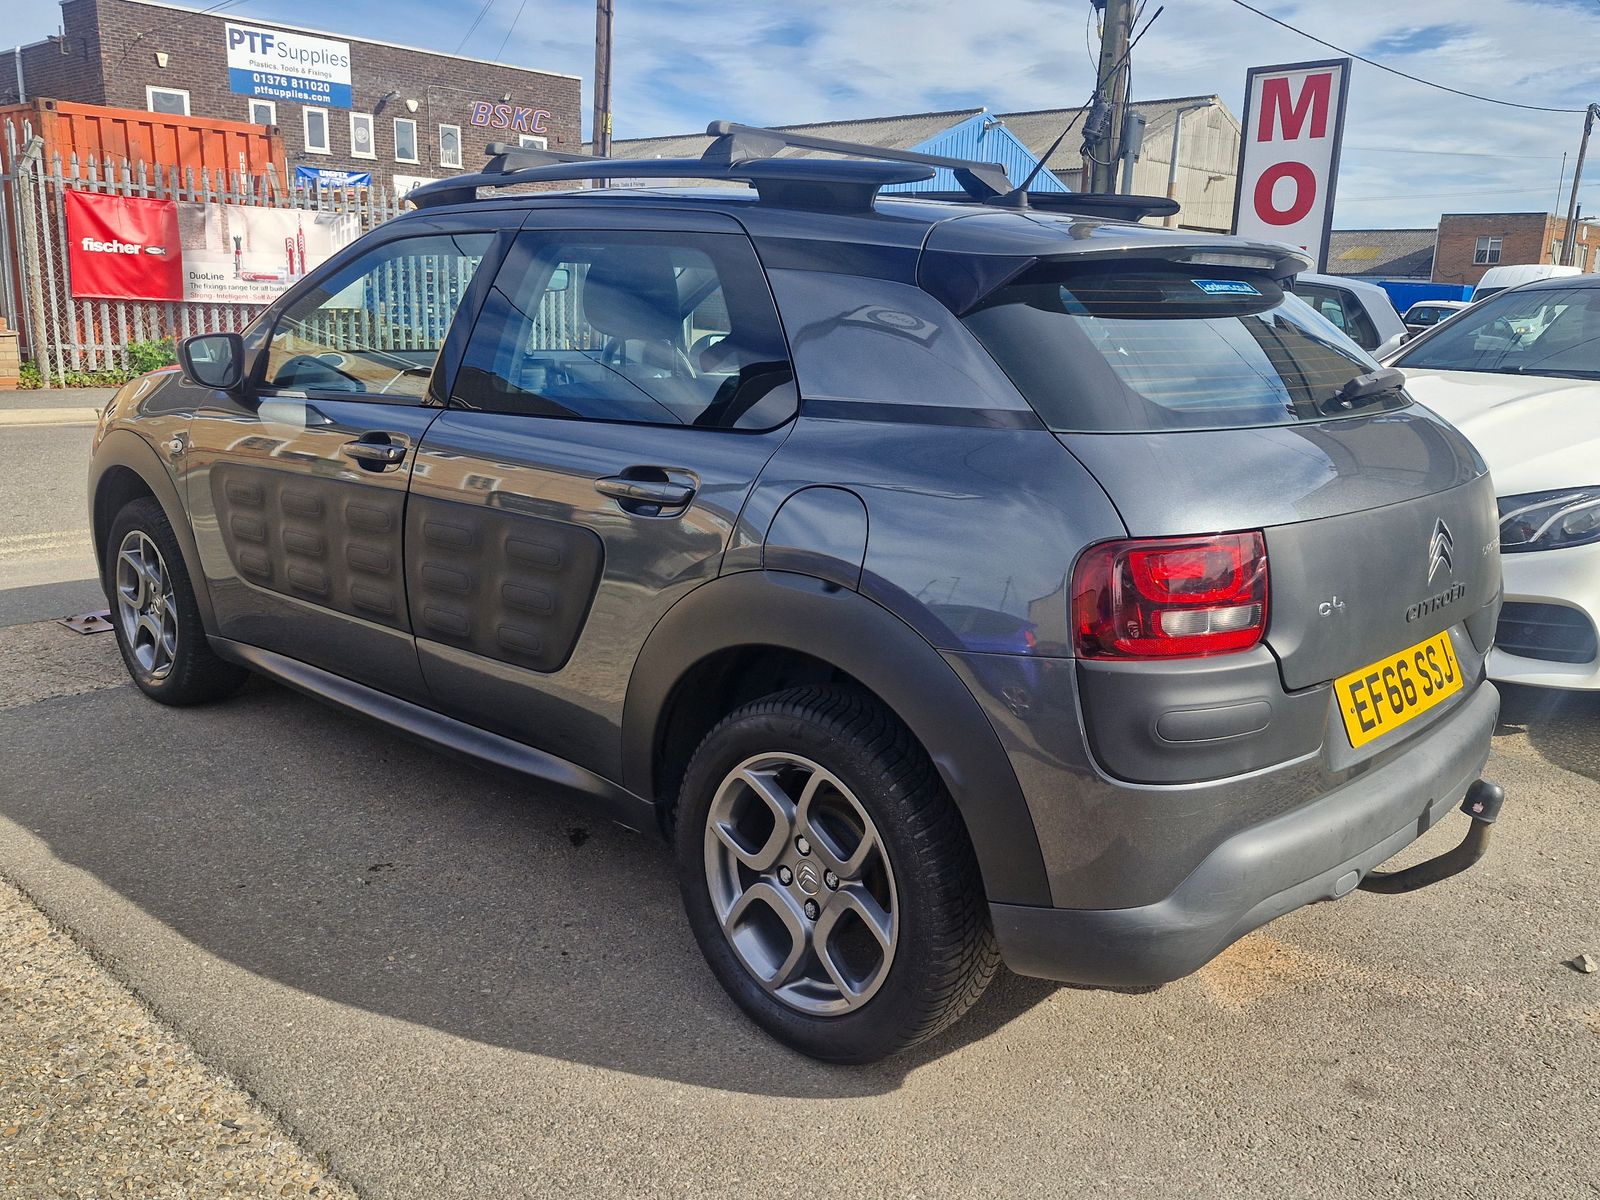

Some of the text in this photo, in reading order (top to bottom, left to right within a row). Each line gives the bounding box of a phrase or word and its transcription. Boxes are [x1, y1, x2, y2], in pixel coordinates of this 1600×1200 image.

[229, 28, 348, 68] PTF Supplies
[281, 64, 299, 74] Tools
[308, 69, 332, 79] Fixings
[253, 73, 330, 92] 01376 811020
[254, 86, 331, 103] ptfsupplies.com
[471, 101, 550, 134] BSKC
[1254, 73, 1332, 250] MO
[81, 237, 142, 255] fischer
[189, 271, 224, 280] DuoLine
[190, 291, 212, 300] Strong
[203, 283, 227, 292] fixings
[249, 283, 259, 291] for
[1349, 638, 1454, 733] EF66 SSJ
